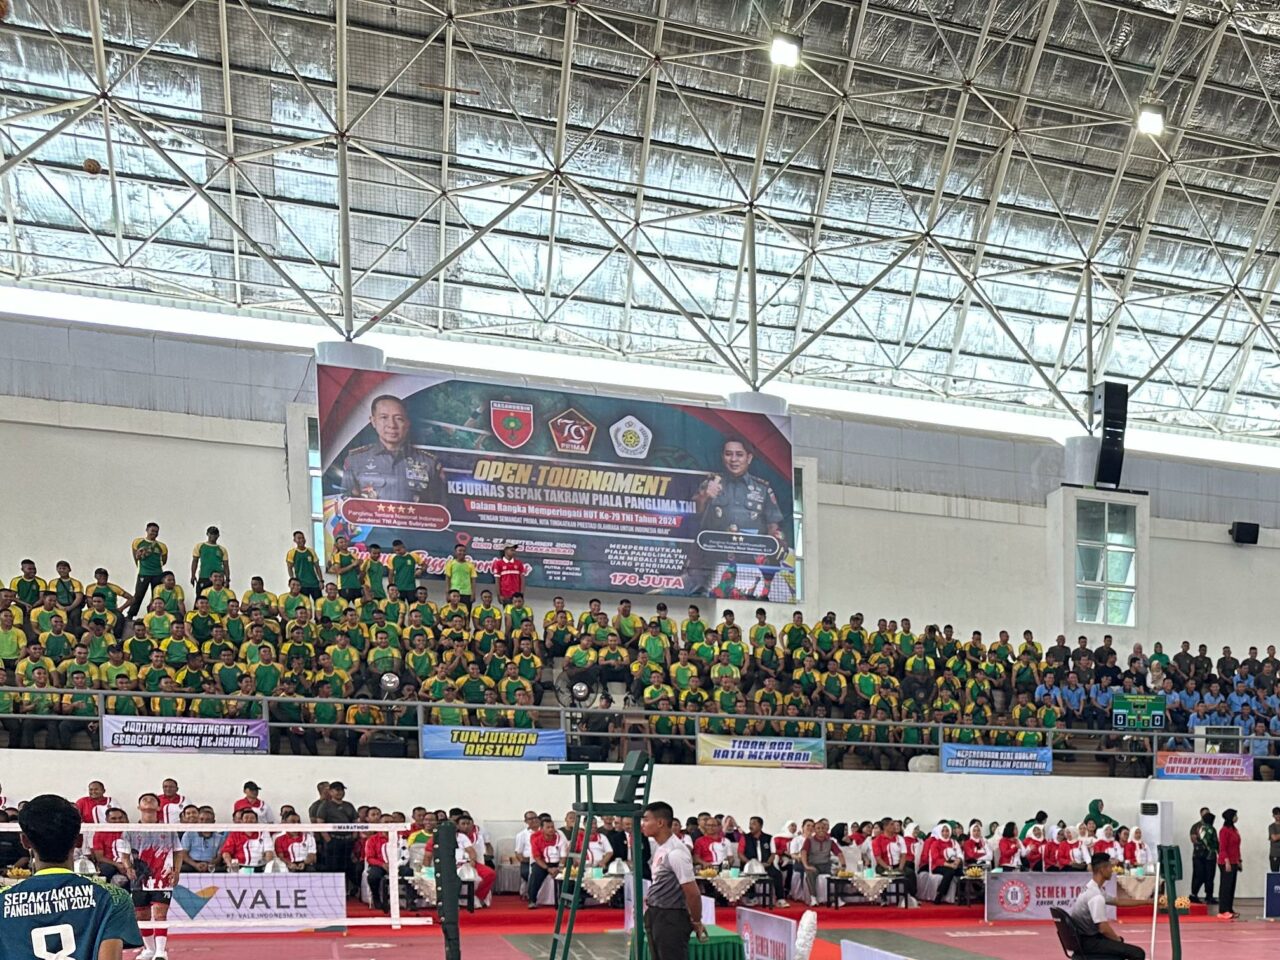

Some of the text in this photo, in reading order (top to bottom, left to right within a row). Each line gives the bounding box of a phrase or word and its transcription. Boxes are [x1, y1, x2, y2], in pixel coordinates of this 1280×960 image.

[474, 460, 671, 496] OPEN TOURNAMENT
[448, 481, 697, 514] KEJURNAS SEPAK TAKRAW PIALA PANGLIMA TNI
[470, 501, 677, 525] Dalam Rangka Memperingati HUT Ke-79 TNI Tahun 2024
[604, 548, 629, 556] PIALA
[630, 550, 672, 558] PANGLIMA
[609, 543, 682, 554] MEMPEREBUTKAN
[634, 562, 683, 570] PEMBINAAN
[610, 573, 684, 589] 178 JUTA
[1117, 714, 1124, 725] 0
[1154, 715, 1161, 726] 0
[124, 722, 249, 735] JADIKAN PERTANDINGAN INI
[113, 734, 259, 748] SEBAGAI PANGGUNG KEJAYAANMU
[451, 731, 538, 745] TUNJUKKAN
[731, 739, 793, 750] TIDAK ADA
[464, 744, 525, 757] AKSIMU
[713, 749, 810, 762] KATA MENYERAH
[4, 884, 94, 906] SEPAKTAKRAW
[1035, 885, 1067, 899] SEMEN
[4, 895, 97, 918] PANGLIMA TNI 2024
[226, 889, 308, 910] VALE
